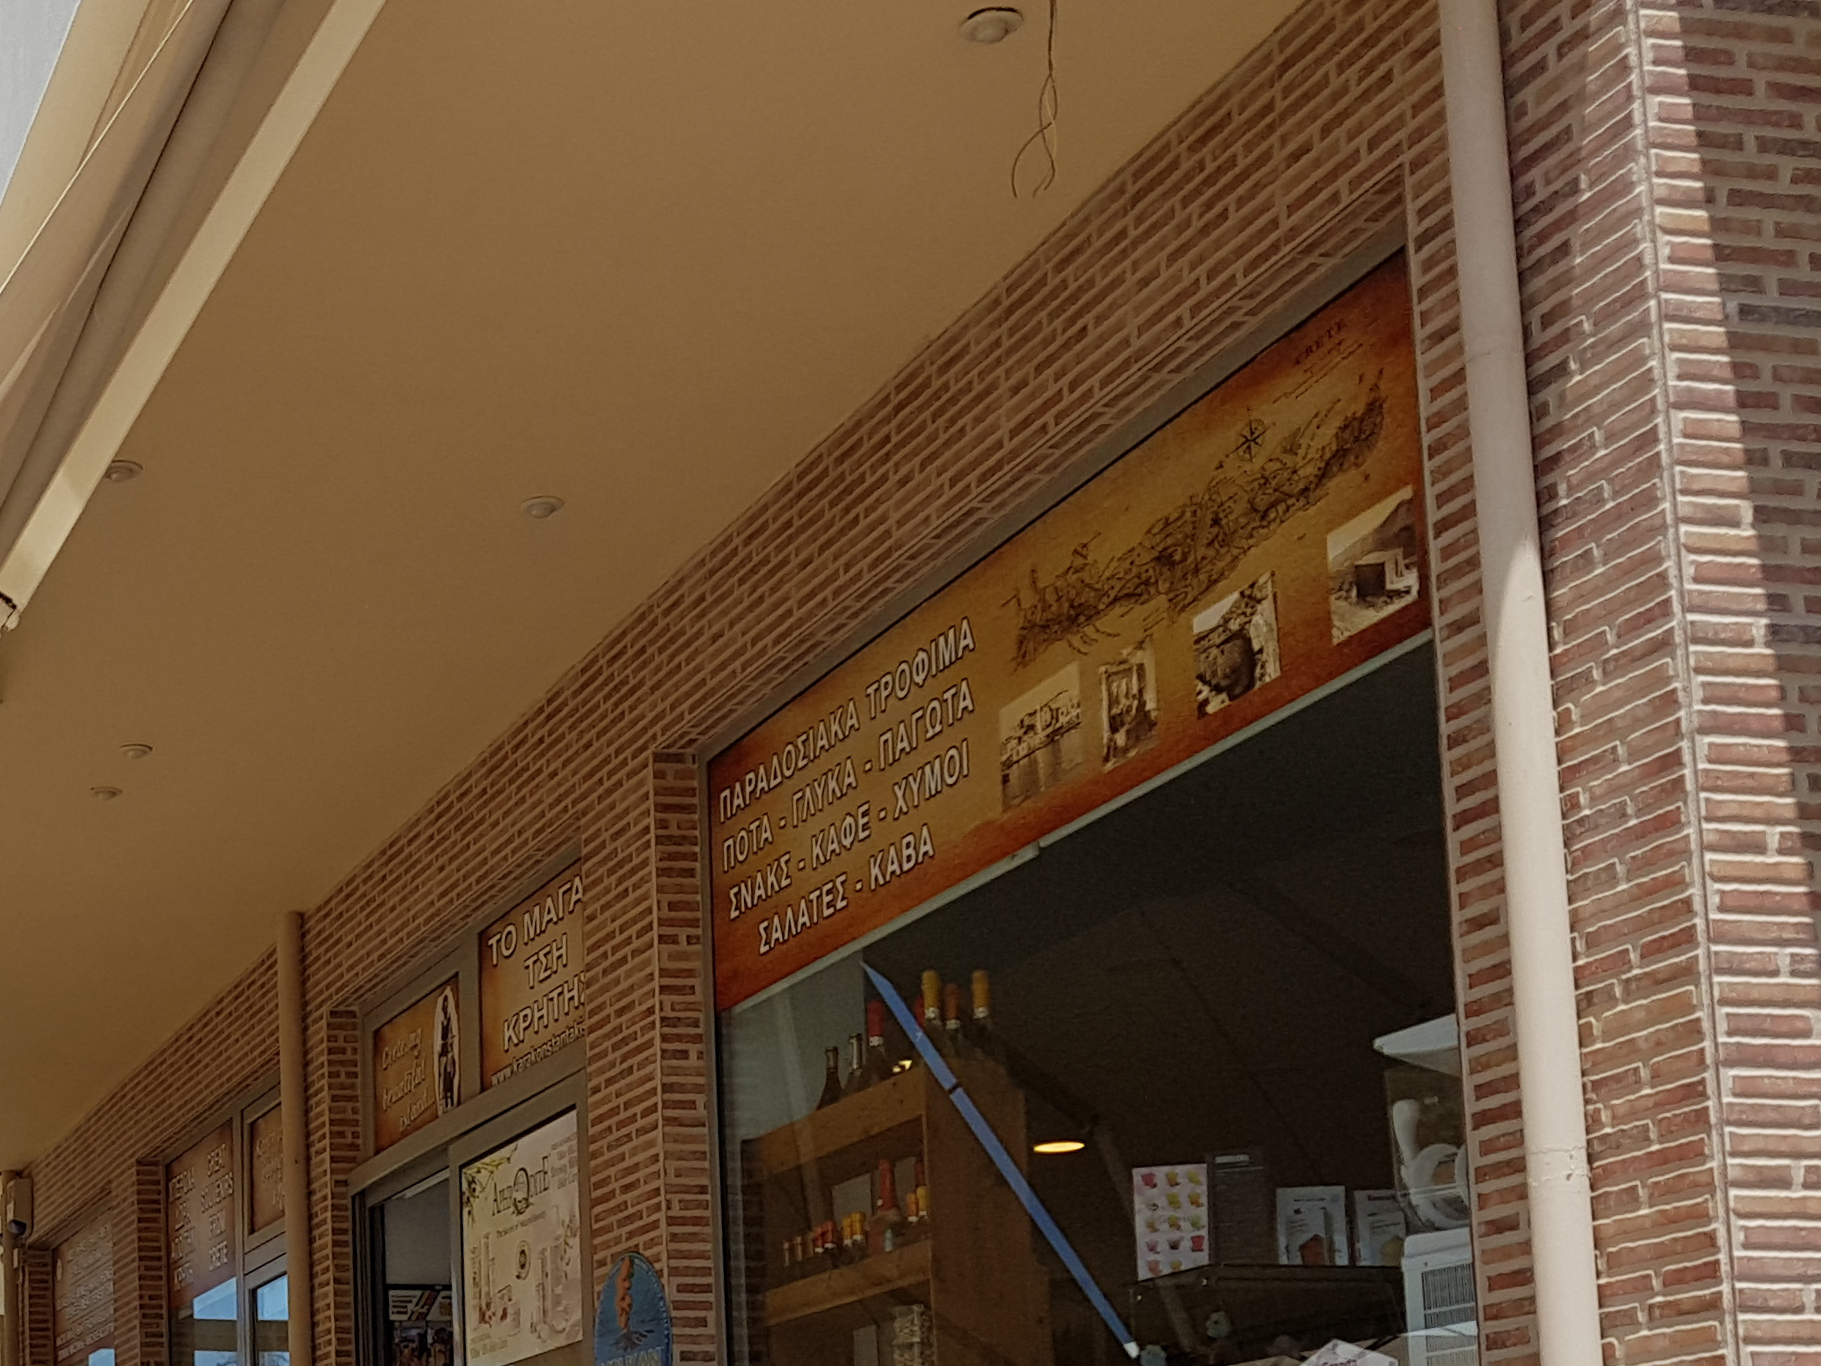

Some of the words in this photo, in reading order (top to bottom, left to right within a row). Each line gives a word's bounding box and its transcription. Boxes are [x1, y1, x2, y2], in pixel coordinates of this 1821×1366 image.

[719, 699, 860, 823] ΠΑΡΑΔΟΣΙΑΚΑ
[866, 617, 976, 719] ΤΡΟΦΙΜΑ
[723, 814, 773, 872] ΠΟΤΑ
[791, 757, 858, 828] ΓΛΥΚΑ
[879, 678, 974, 771] ΠΑΓΩΤΑ
[729, 852, 792, 920] ΣΝΑΚΣ
[811, 801, 871, 869] ΚΑΦΕ
[893, 739, 970, 821] ΧΥΜΟΙ
[758, 873, 849, 955] ΣΑΛΑΤΕΣ
[868, 824, 935, 892] ΚΑΒΑ
[488, 924, 517, 966] ΤΟ
[524, 933, 567, 989] ΤΣΗ
